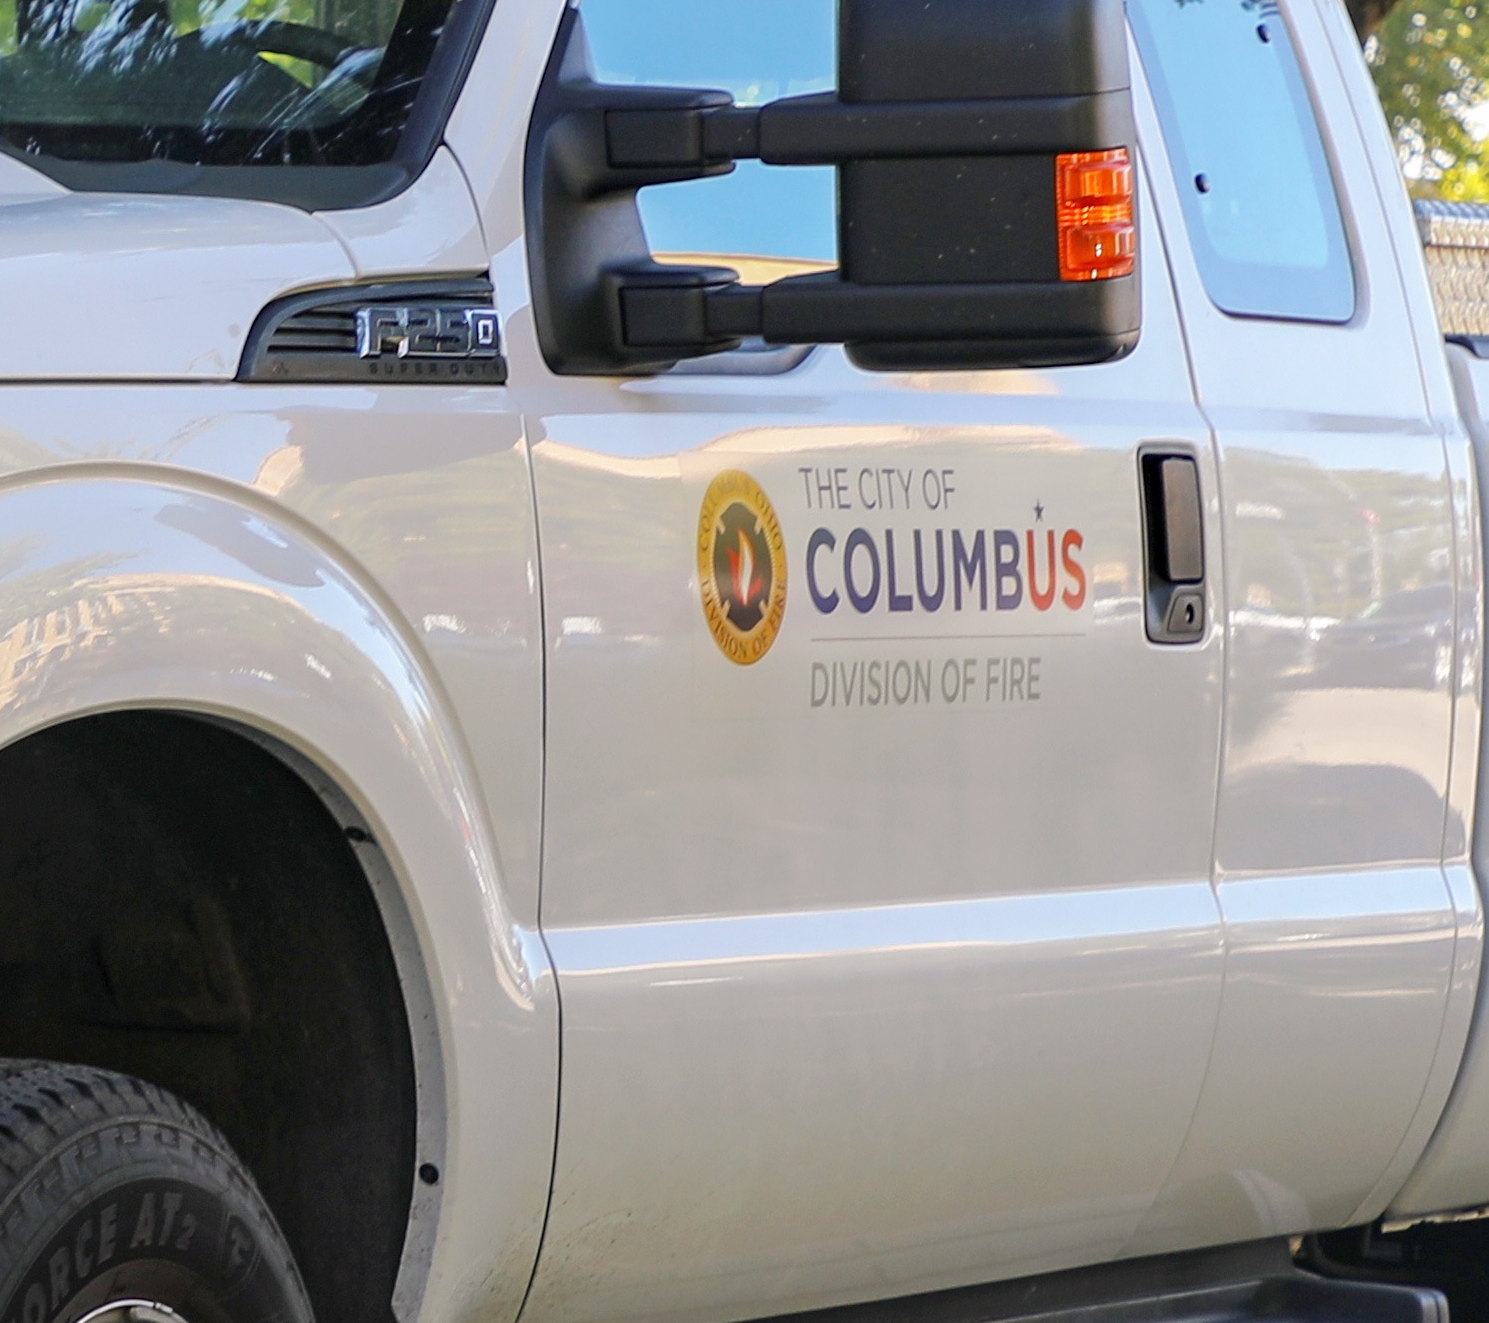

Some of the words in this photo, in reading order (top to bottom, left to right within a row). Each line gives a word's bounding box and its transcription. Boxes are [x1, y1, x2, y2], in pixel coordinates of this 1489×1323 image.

[798, 468, 852, 510] THE
[858, 468, 914, 510] CITY
[922, 469, 956, 510] OF
[806, 527, 1087, 614] COLUMBUS
[810, 659, 931, 708] DIVISION
[941, 658, 976, 705] OF
[986, 656, 1042, 703] FIRE
